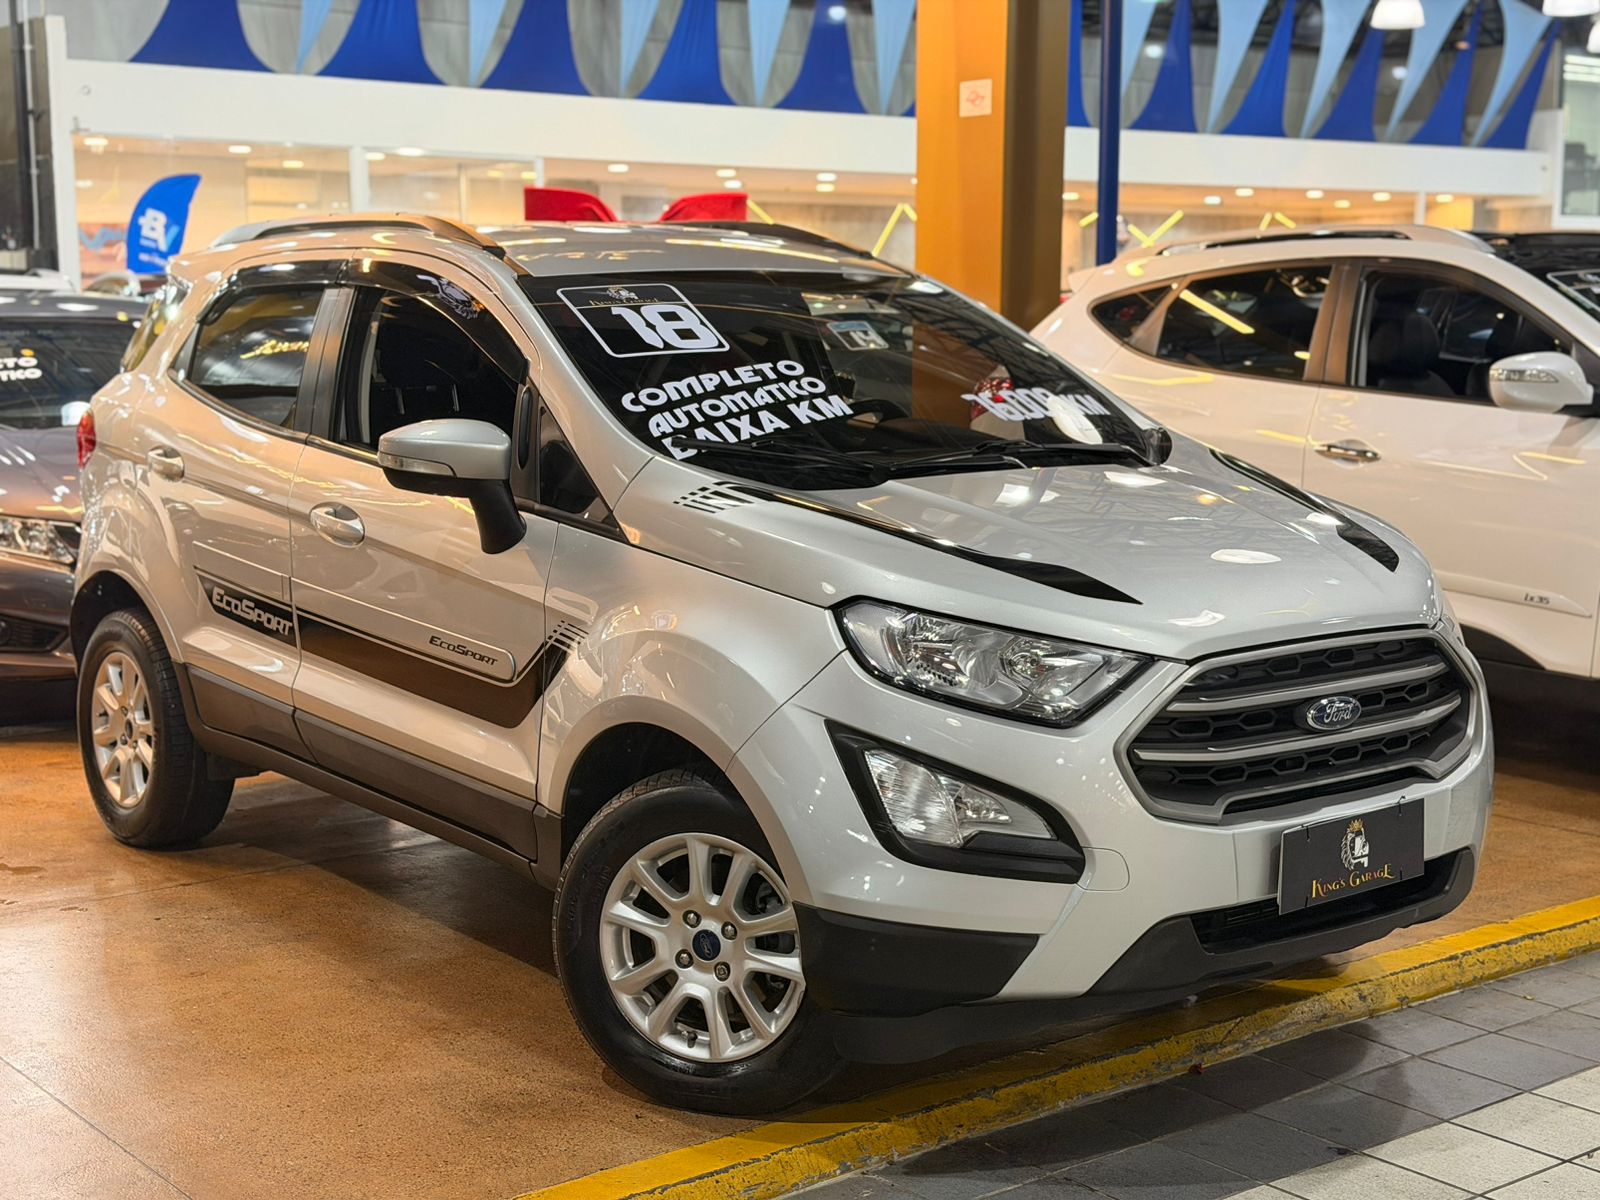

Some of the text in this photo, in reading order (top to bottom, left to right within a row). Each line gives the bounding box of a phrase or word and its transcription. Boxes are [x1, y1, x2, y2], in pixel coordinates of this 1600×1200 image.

[611, 304, 719, 349] 18
[621, 360, 805, 413] COMPLETO
[648, 377, 826, 438] AUTOMATICO
[788, 395, 853, 424] KM
[1323, 703, 1352, 724] Ford
